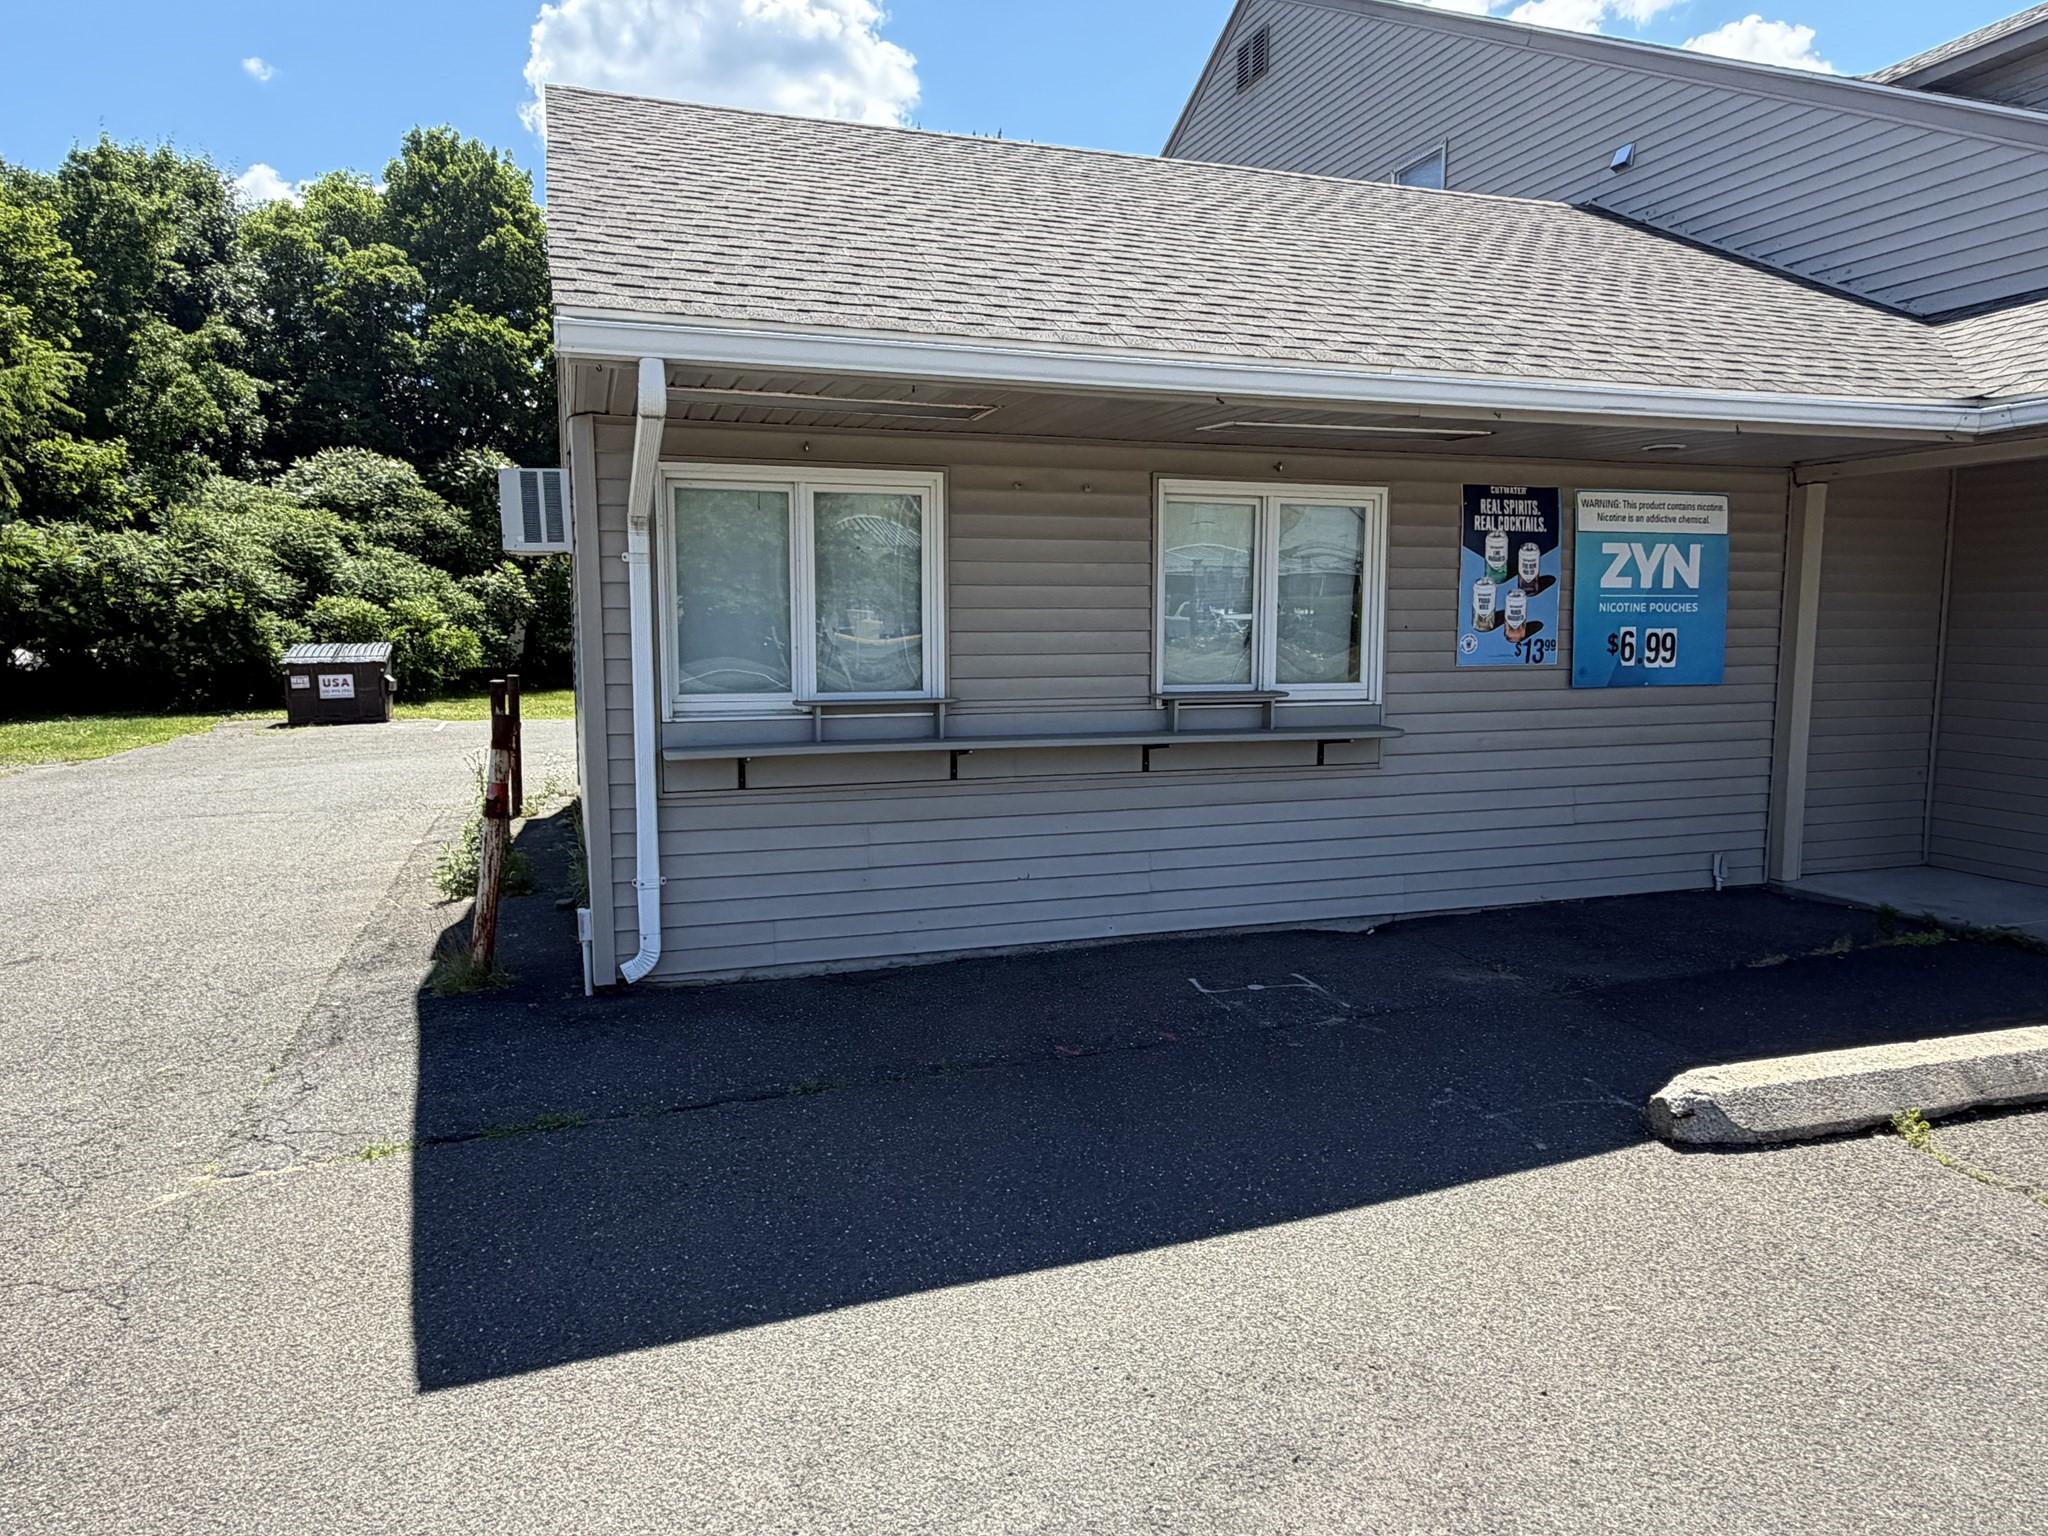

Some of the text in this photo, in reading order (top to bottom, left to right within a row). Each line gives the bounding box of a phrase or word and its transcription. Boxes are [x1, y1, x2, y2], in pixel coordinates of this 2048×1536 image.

[1480, 498, 1541, 515] REAL SPIRITS.
[1581, 499, 1726, 512] WARNING: This product contains nicotine.
[1474, 515, 1547, 533] REAL COCKTAILS.
[1597, 512, 1710, 524] Nicotine is an addictive chemical.
[1600, 542, 1701, 589] ZYN
[1599, 602, 1699, 613] NICOTINE POUCHES
[1606, 630, 1677, 665] $6.99
[322, 678, 350, 687] USA
